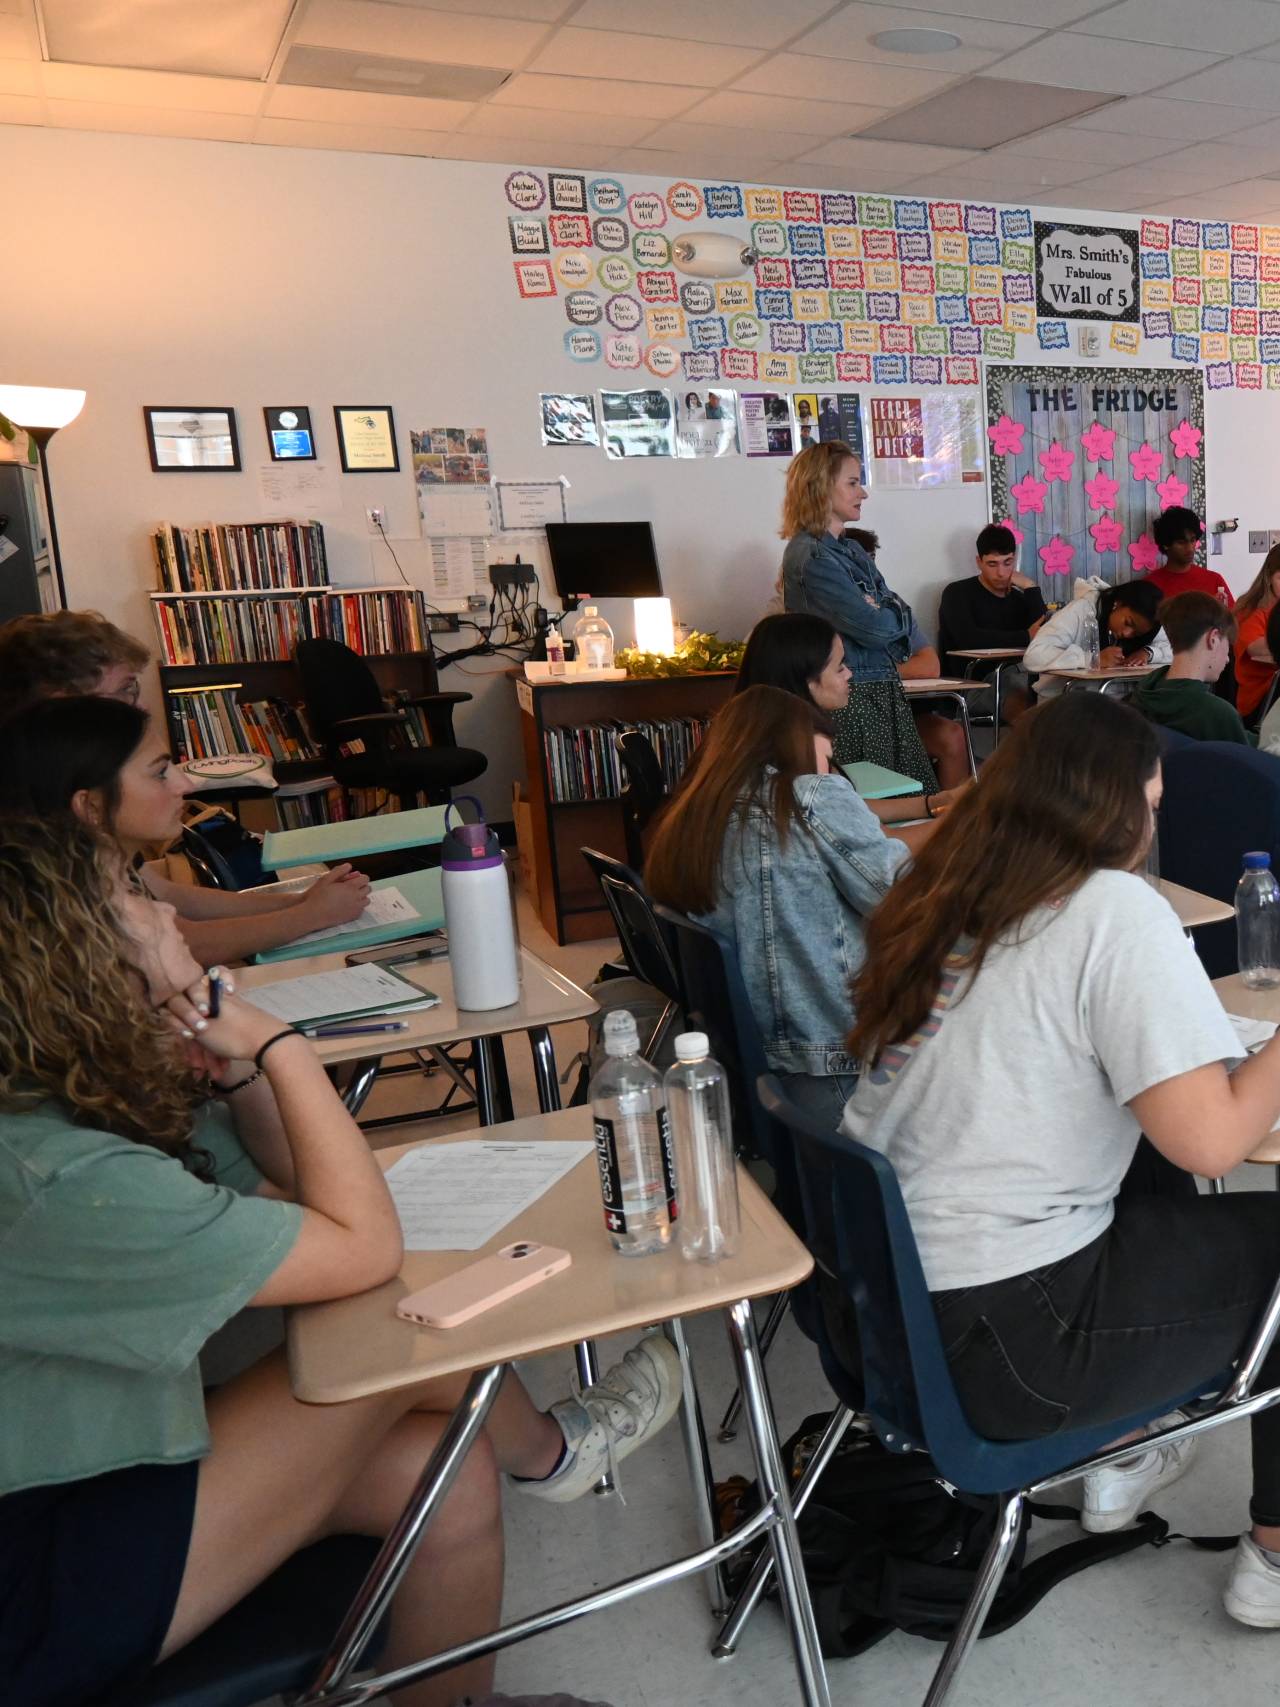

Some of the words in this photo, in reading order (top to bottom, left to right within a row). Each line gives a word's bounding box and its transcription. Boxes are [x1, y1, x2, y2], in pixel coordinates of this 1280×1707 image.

[515, 193, 538, 202] Clark
[639, 211, 653, 220] Hill
[560, 230, 583, 239] Clark
[1046, 244, 1075, 259] Mrs.
[1080, 247, 1129, 264] Smith's
[1065, 267, 1111, 280] Fabulous
[1050, 284, 1090, 305] Wall
[1097, 288, 1113, 305] of
[1118, 289, 1127, 307] 5
[771, 359, 786, 368] Amy
[872, 400, 910, 419] TEACH
[1026, 389, 1077, 412] THE
[1092, 389, 1178, 412] FRIDGE
[876, 438, 912, 456] POETS
[594, 1123, 613, 1203] essentia
